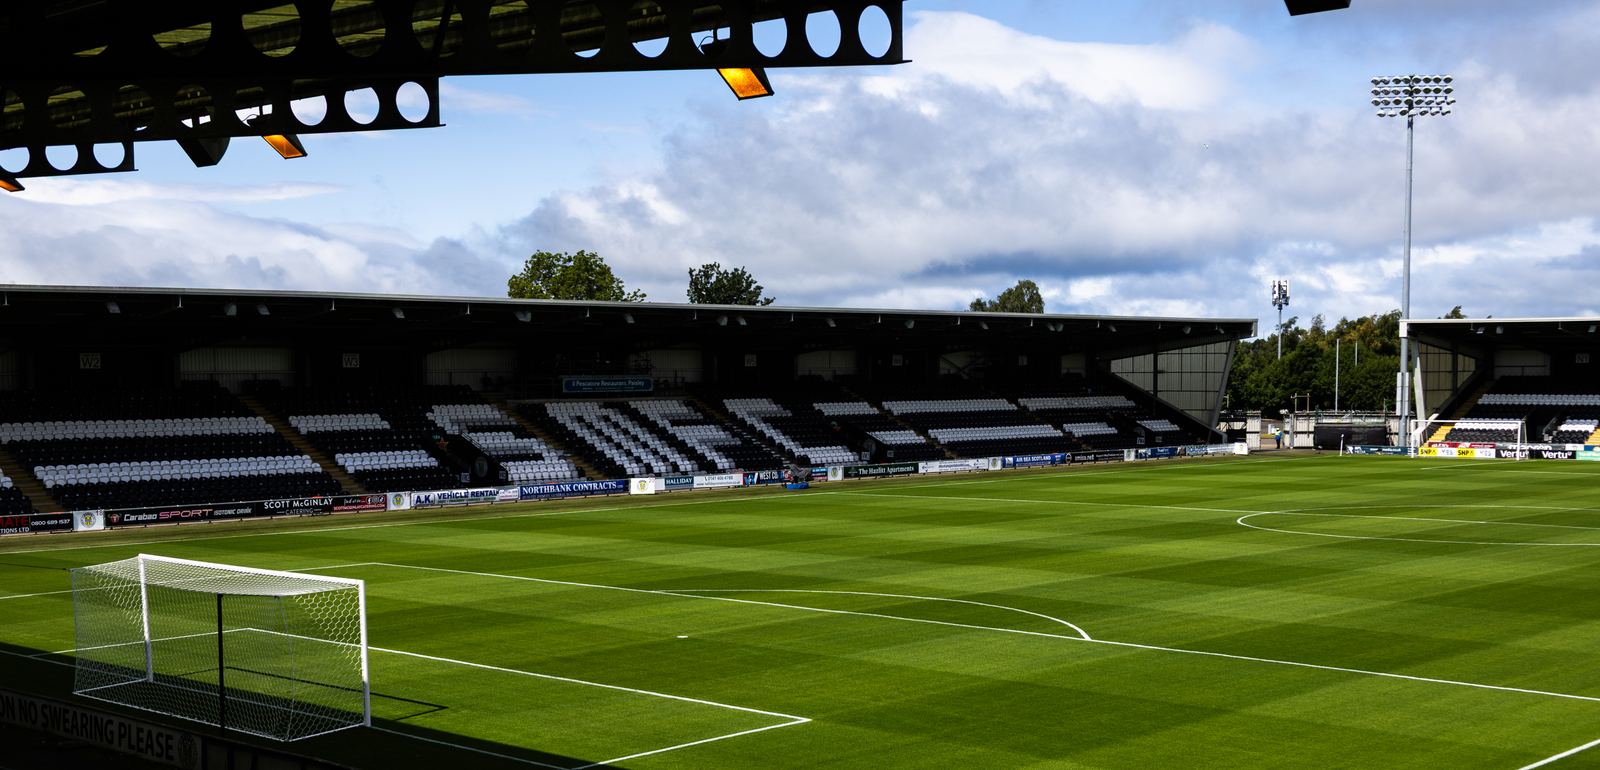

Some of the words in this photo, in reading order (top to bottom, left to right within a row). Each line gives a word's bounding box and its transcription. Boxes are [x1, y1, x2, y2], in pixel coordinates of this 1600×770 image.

[81, 357, 99, 368] W2
[343, 357, 359, 367] W3
[1541, 451, 1568, 459] Vertu
[886, 466, 914, 474] Apartments
[759, 471, 771, 480] WEST
[666, 477, 692, 485] HALLIDAY
[522, 485, 572, 495] NORTHBANK
[572, 481, 617, 492] CONTRACTS
[415, 495, 434, 504] A.K.
[437, 491, 469, 500] VEHICLE
[263, 501, 290, 509] SCOTT
[292, 498, 333, 508] McGINLAY
[123, 513, 157, 522] Carabao
[159, 508, 213, 520] SPORT
[285, 508, 314, 516] CATERING
[18, 698, 37, 726] NO
[41, 703, 114, 745] SWEARING
[118, 722, 173, 761] PLEASE
